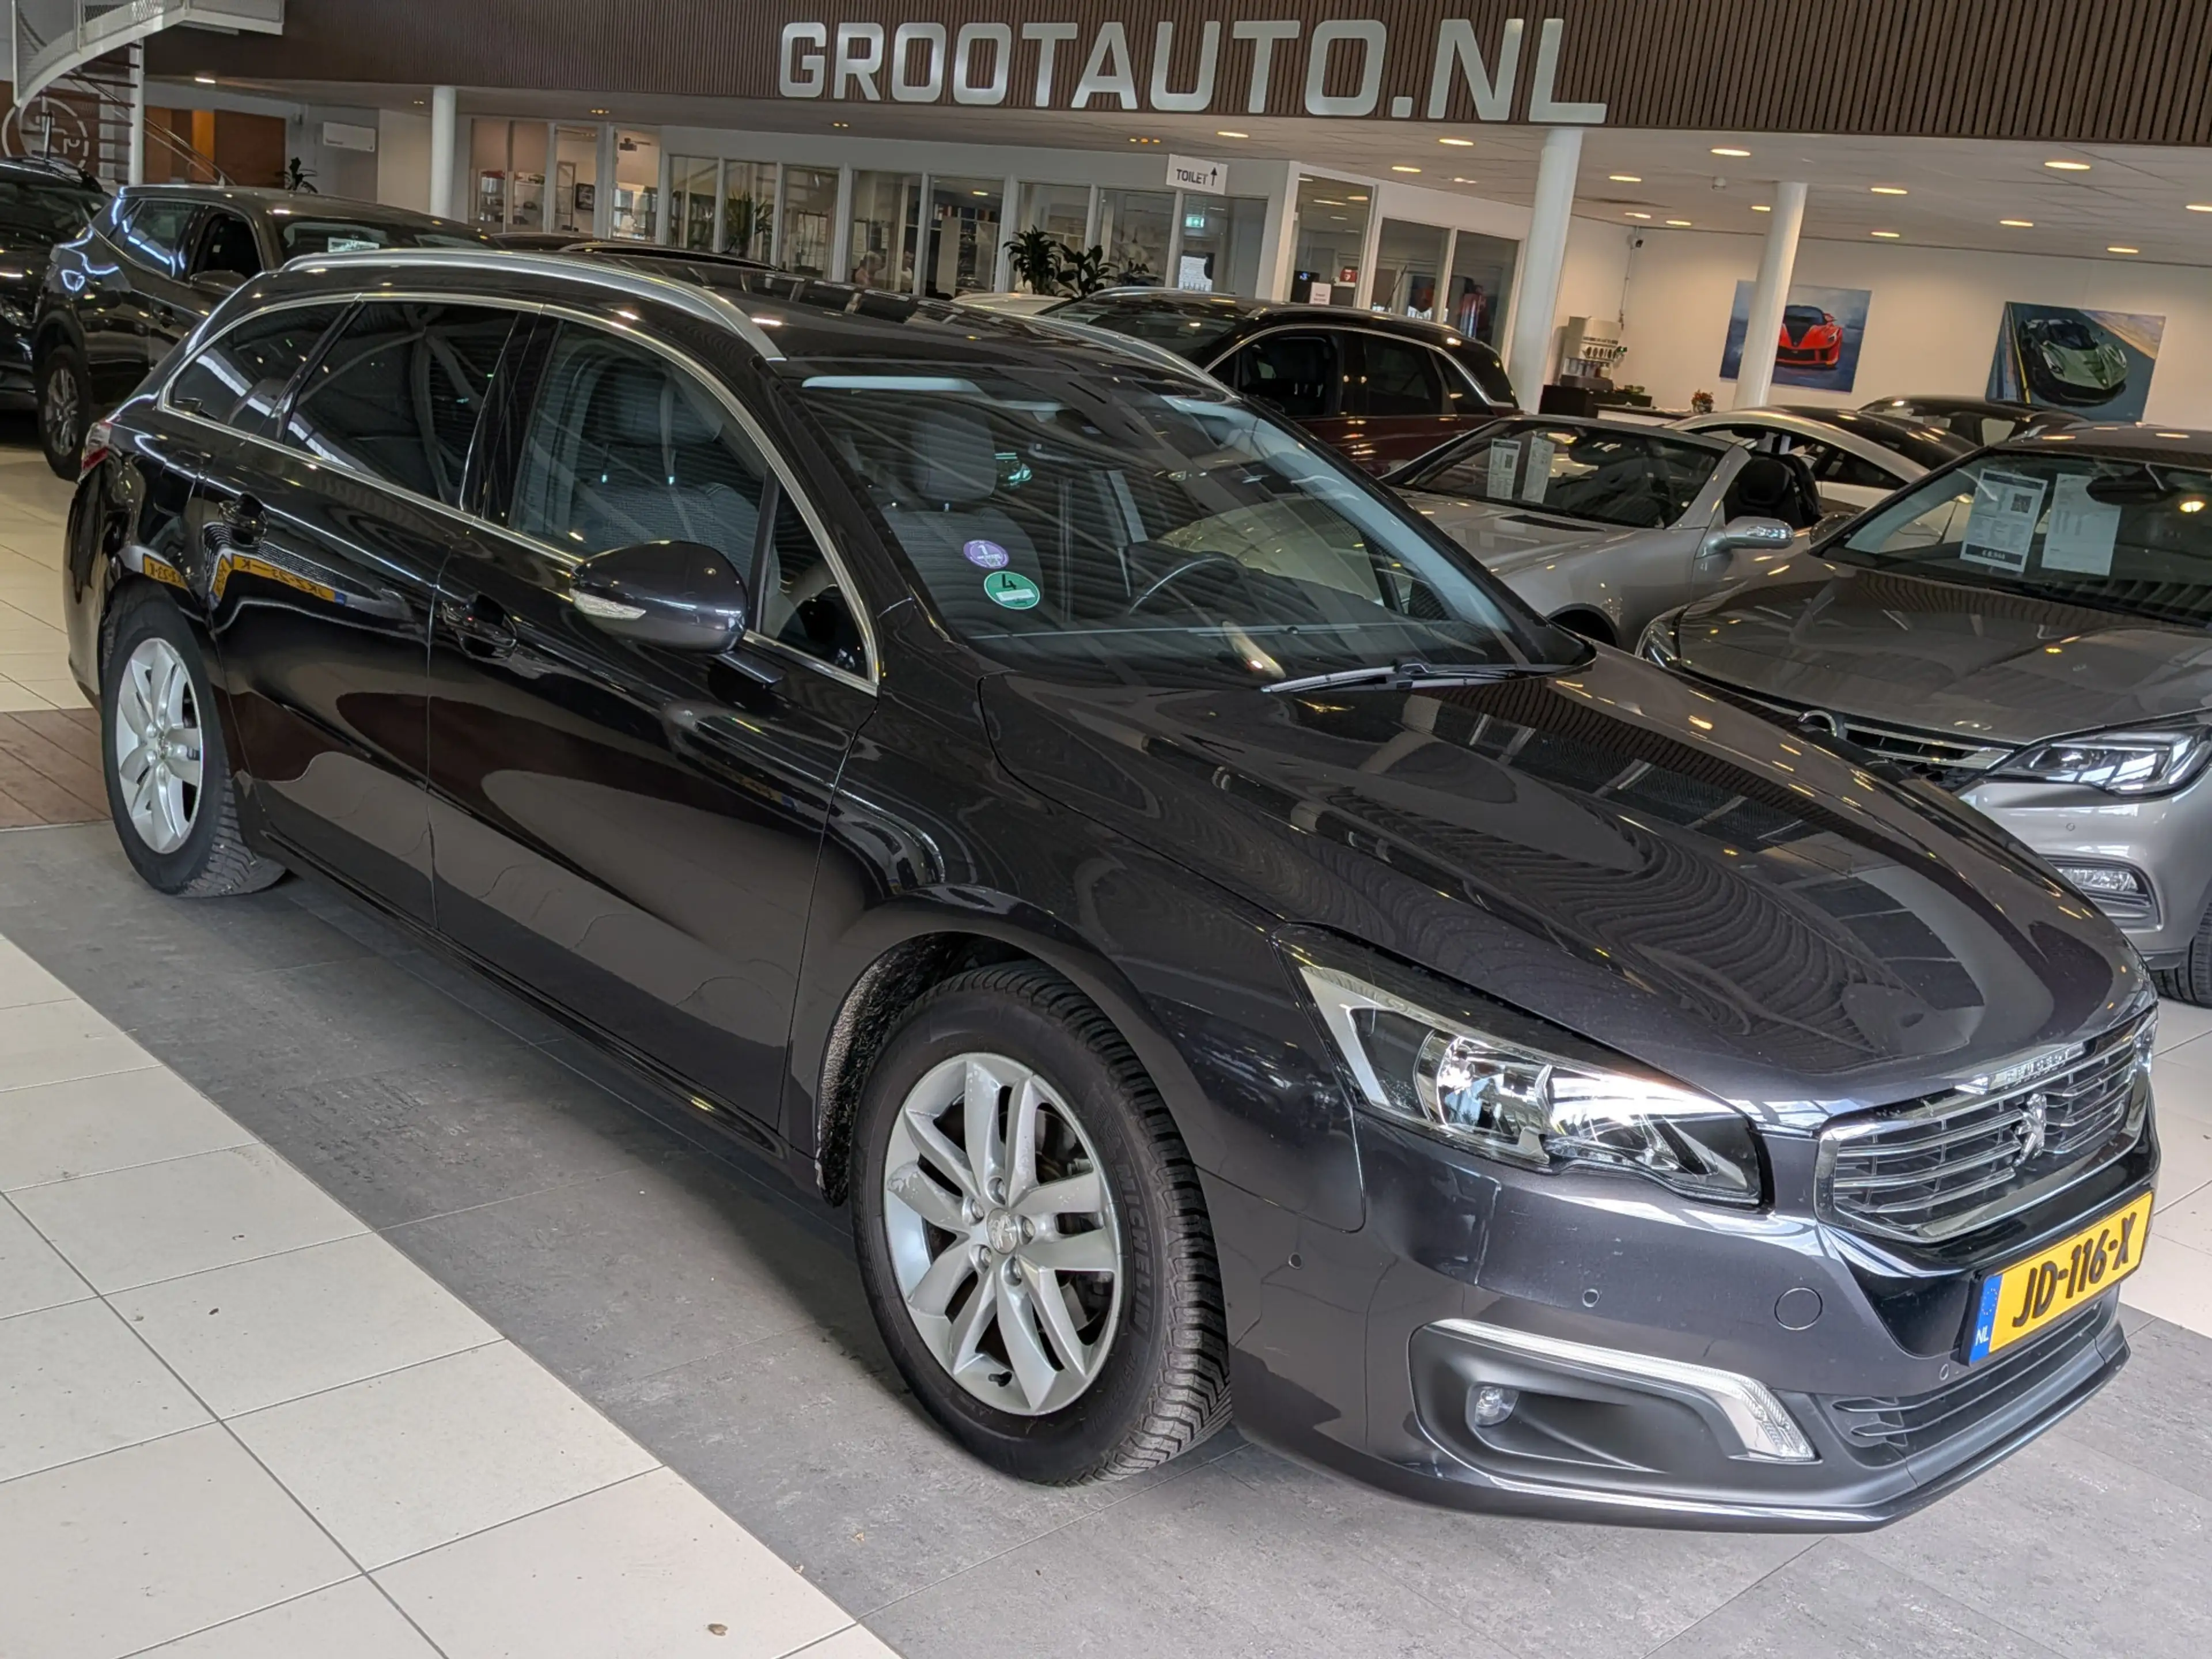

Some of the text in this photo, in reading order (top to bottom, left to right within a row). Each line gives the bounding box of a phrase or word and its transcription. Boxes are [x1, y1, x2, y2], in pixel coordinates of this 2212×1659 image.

[779, 18, 1607, 124] GROOTAUTO.NL
[1176, 168, 1207, 185] TOILET
[1002, 574, 1017, 589] 4
[1114, 1162, 1152, 1332] MICHELIN
[2012, 1212, 2137, 1328] JD-116-X
[1975, 1328, 1989, 1346] NL
